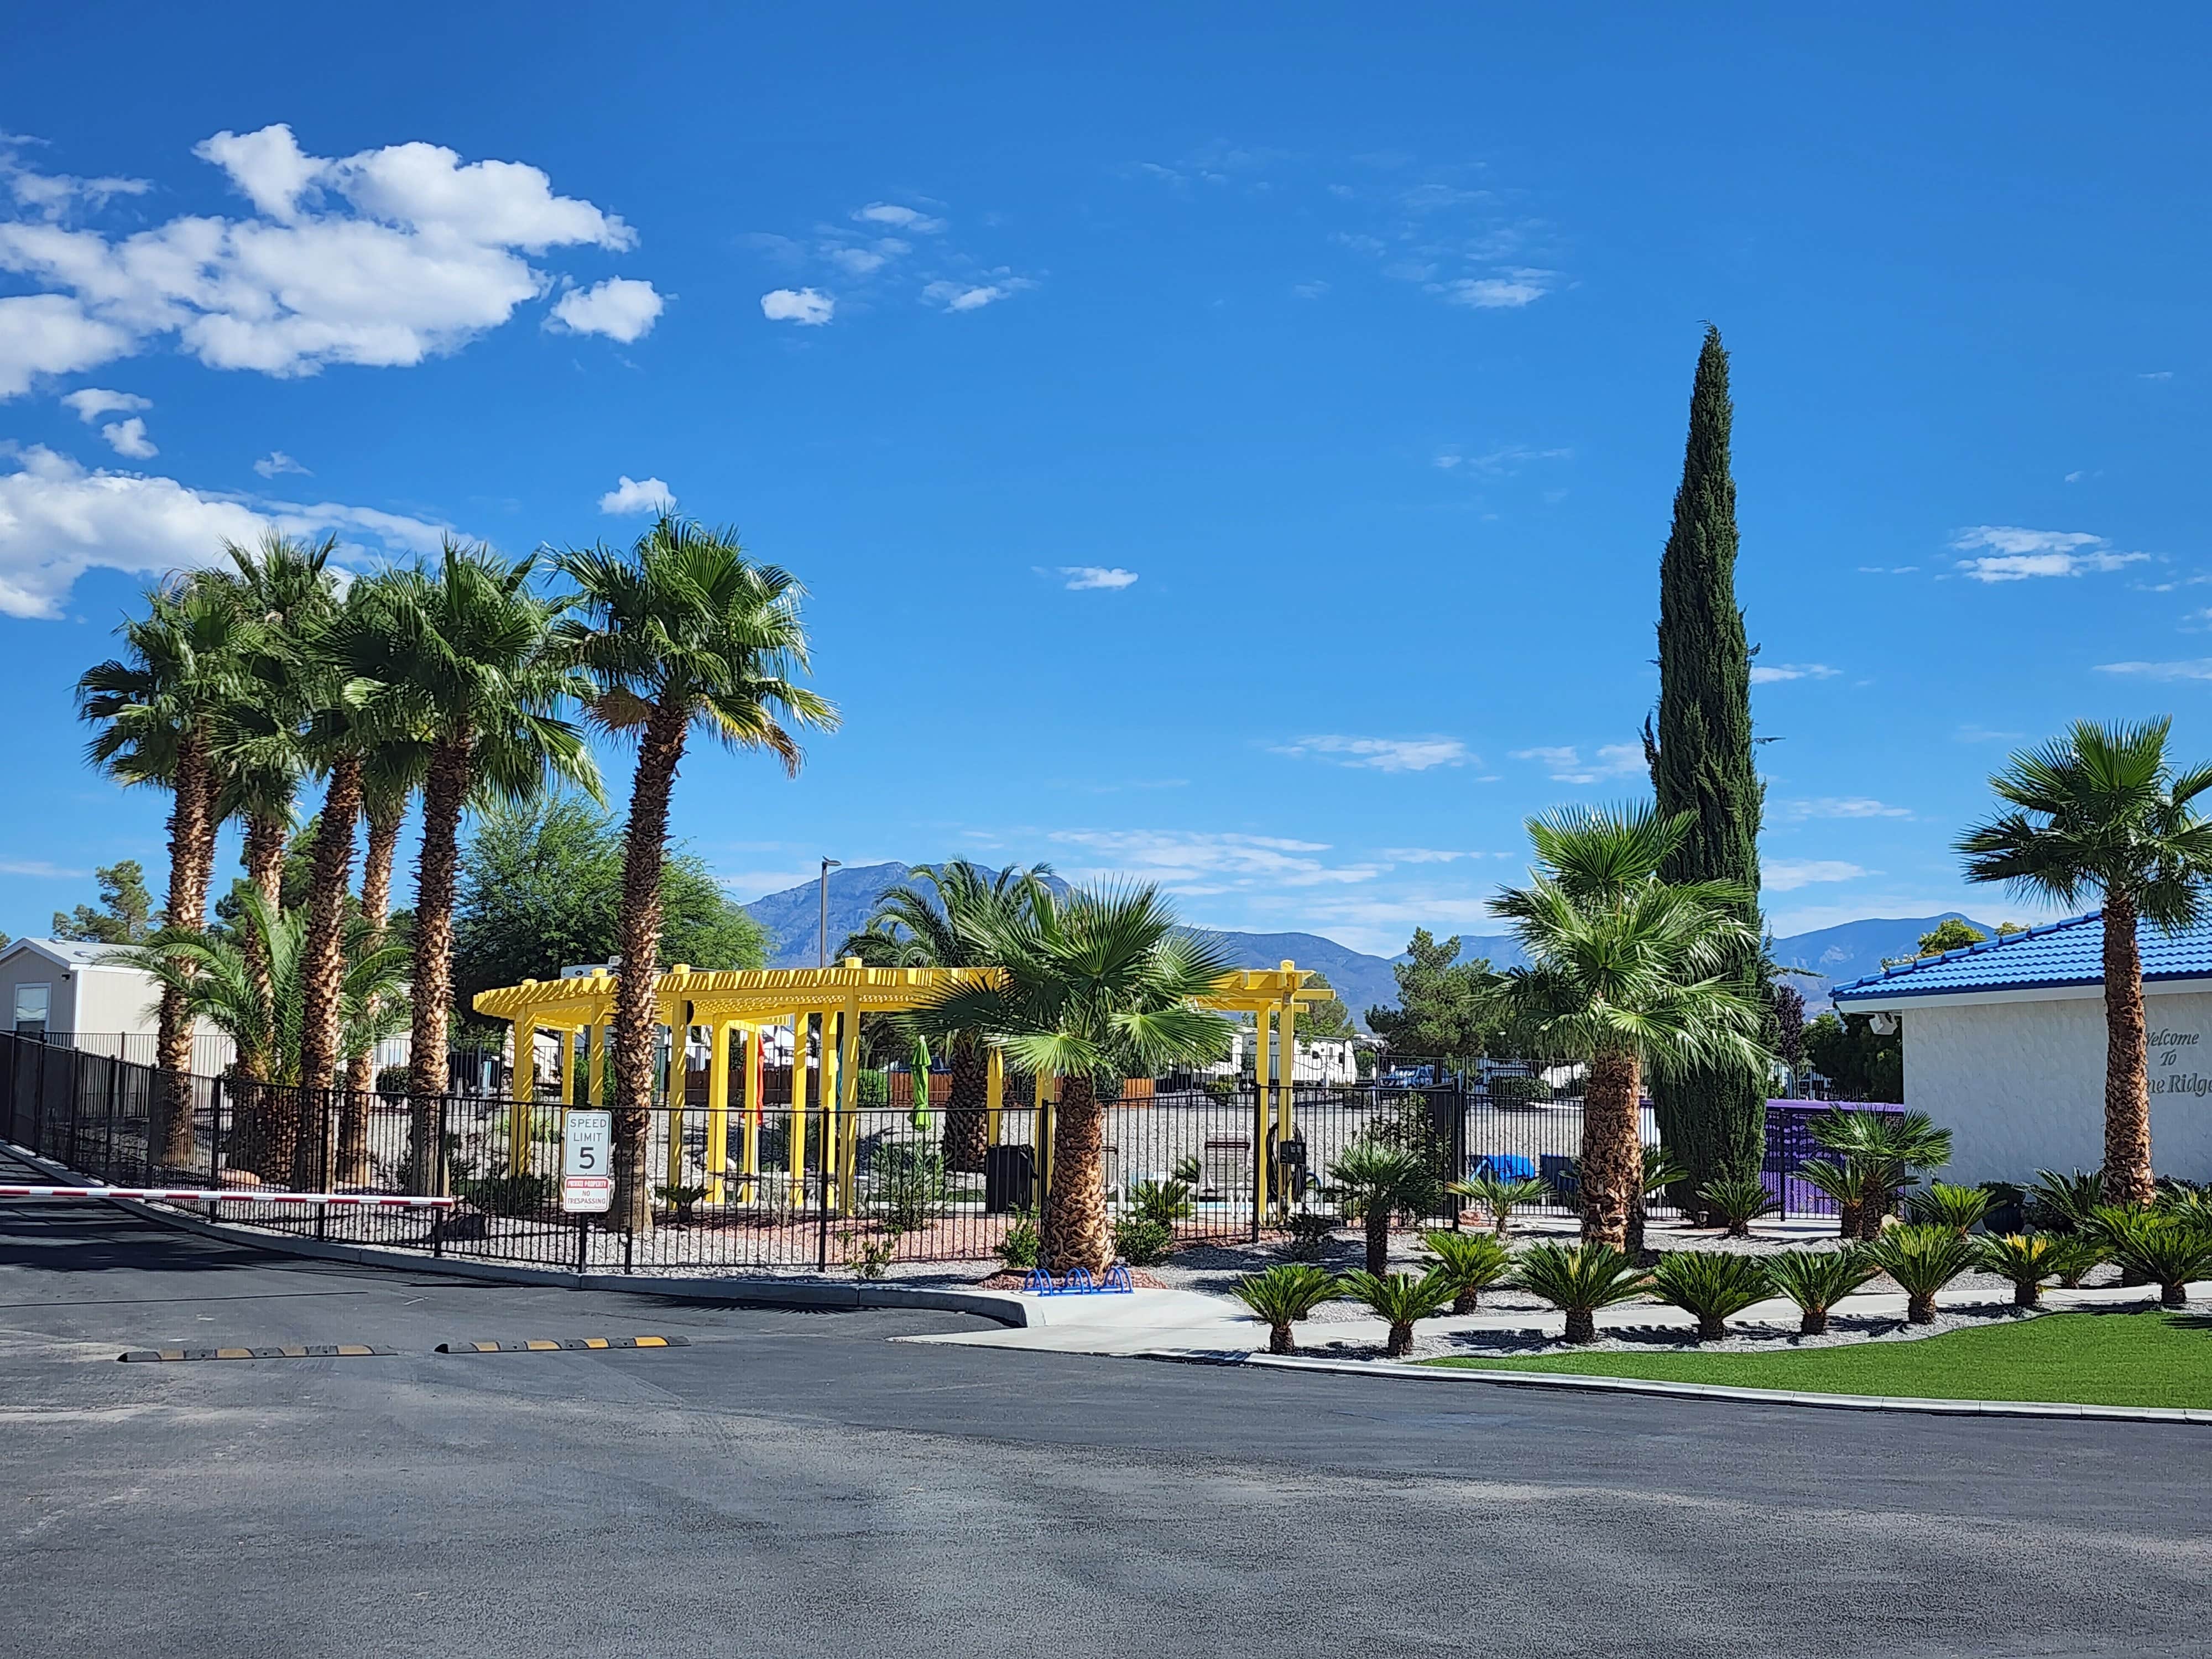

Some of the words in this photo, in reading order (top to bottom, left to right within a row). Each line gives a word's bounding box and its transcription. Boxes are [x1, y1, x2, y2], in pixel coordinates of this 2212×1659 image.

[2159, 1048, 2177, 1066] To
[570, 1118, 607, 1128] SPEED
[573, 1132, 602, 1142] LIMIT
[579, 1146, 594, 1169] 5
